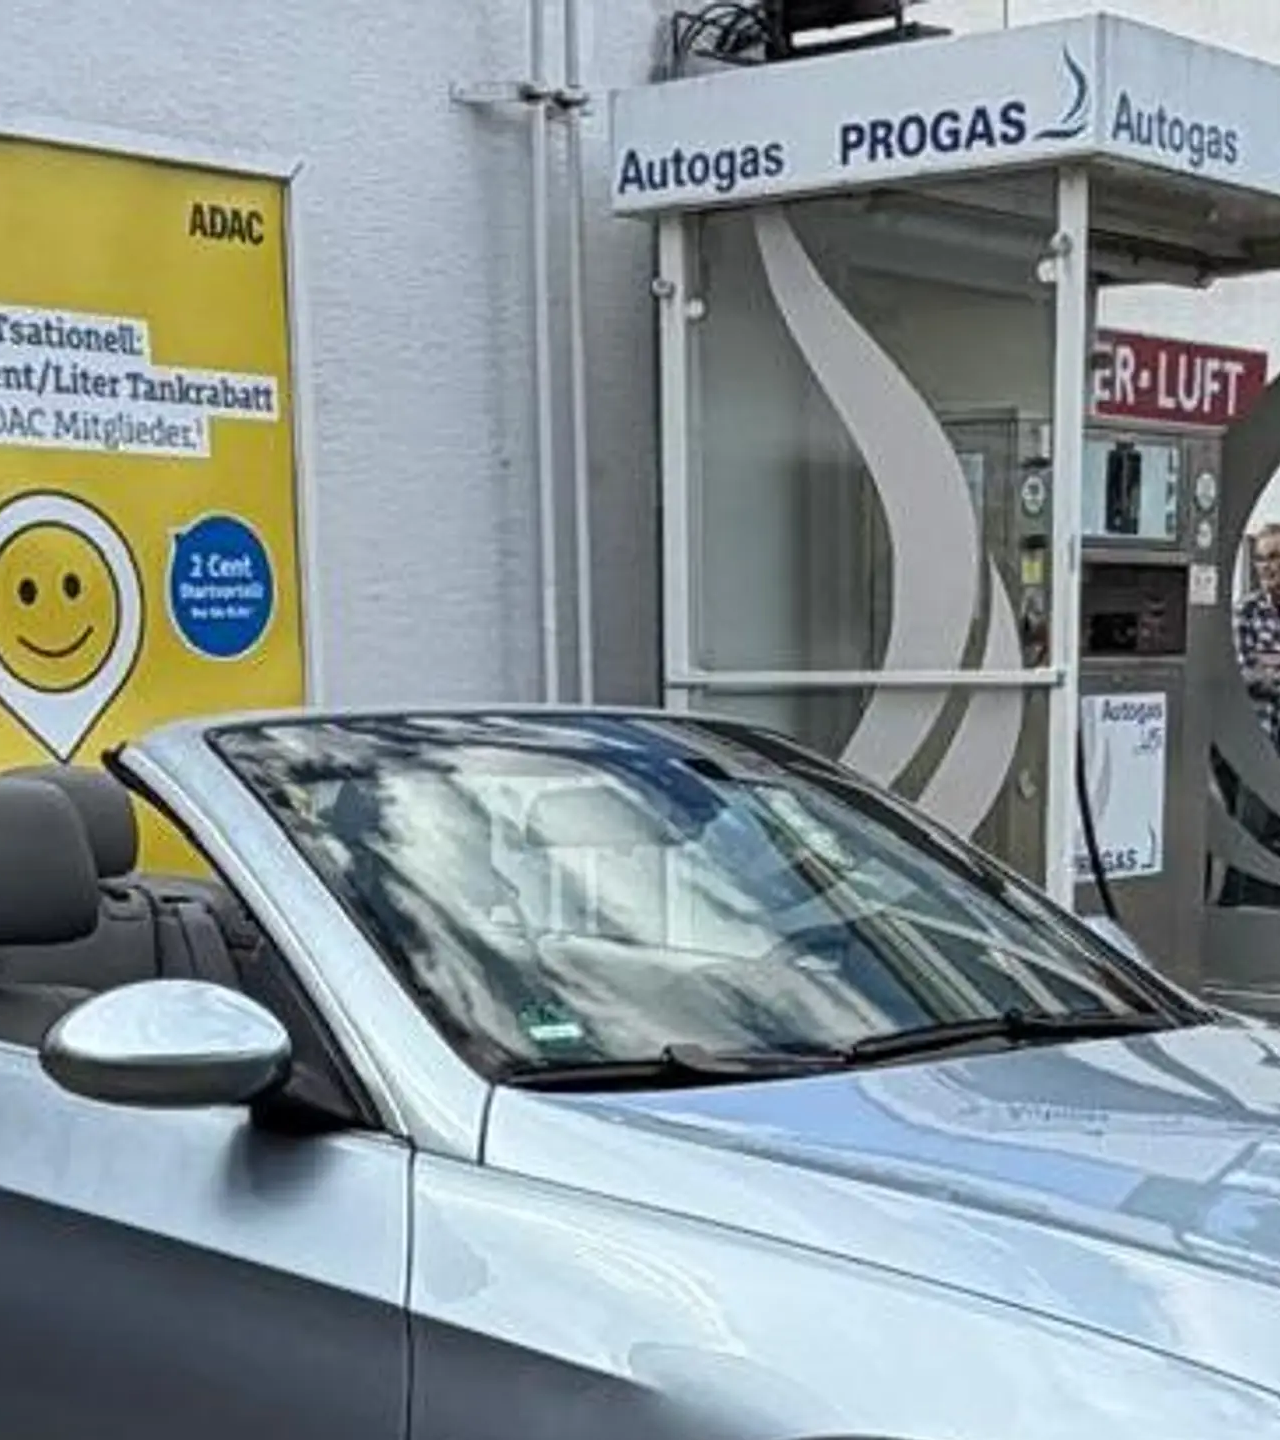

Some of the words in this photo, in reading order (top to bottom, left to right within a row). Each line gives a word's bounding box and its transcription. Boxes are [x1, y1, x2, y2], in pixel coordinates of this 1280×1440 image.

[619, 142, 784, 194] Autogas
[839, 100, 1028, 166] PROGAS
[1111, 91, 1239, 168] Autogas
[189, 203, 264, 245] ADAC
[125, 371, 274, 412] Tankrabatt
[189, 553, 203, 578] 2
[207, 552, 253, 578] Cent
